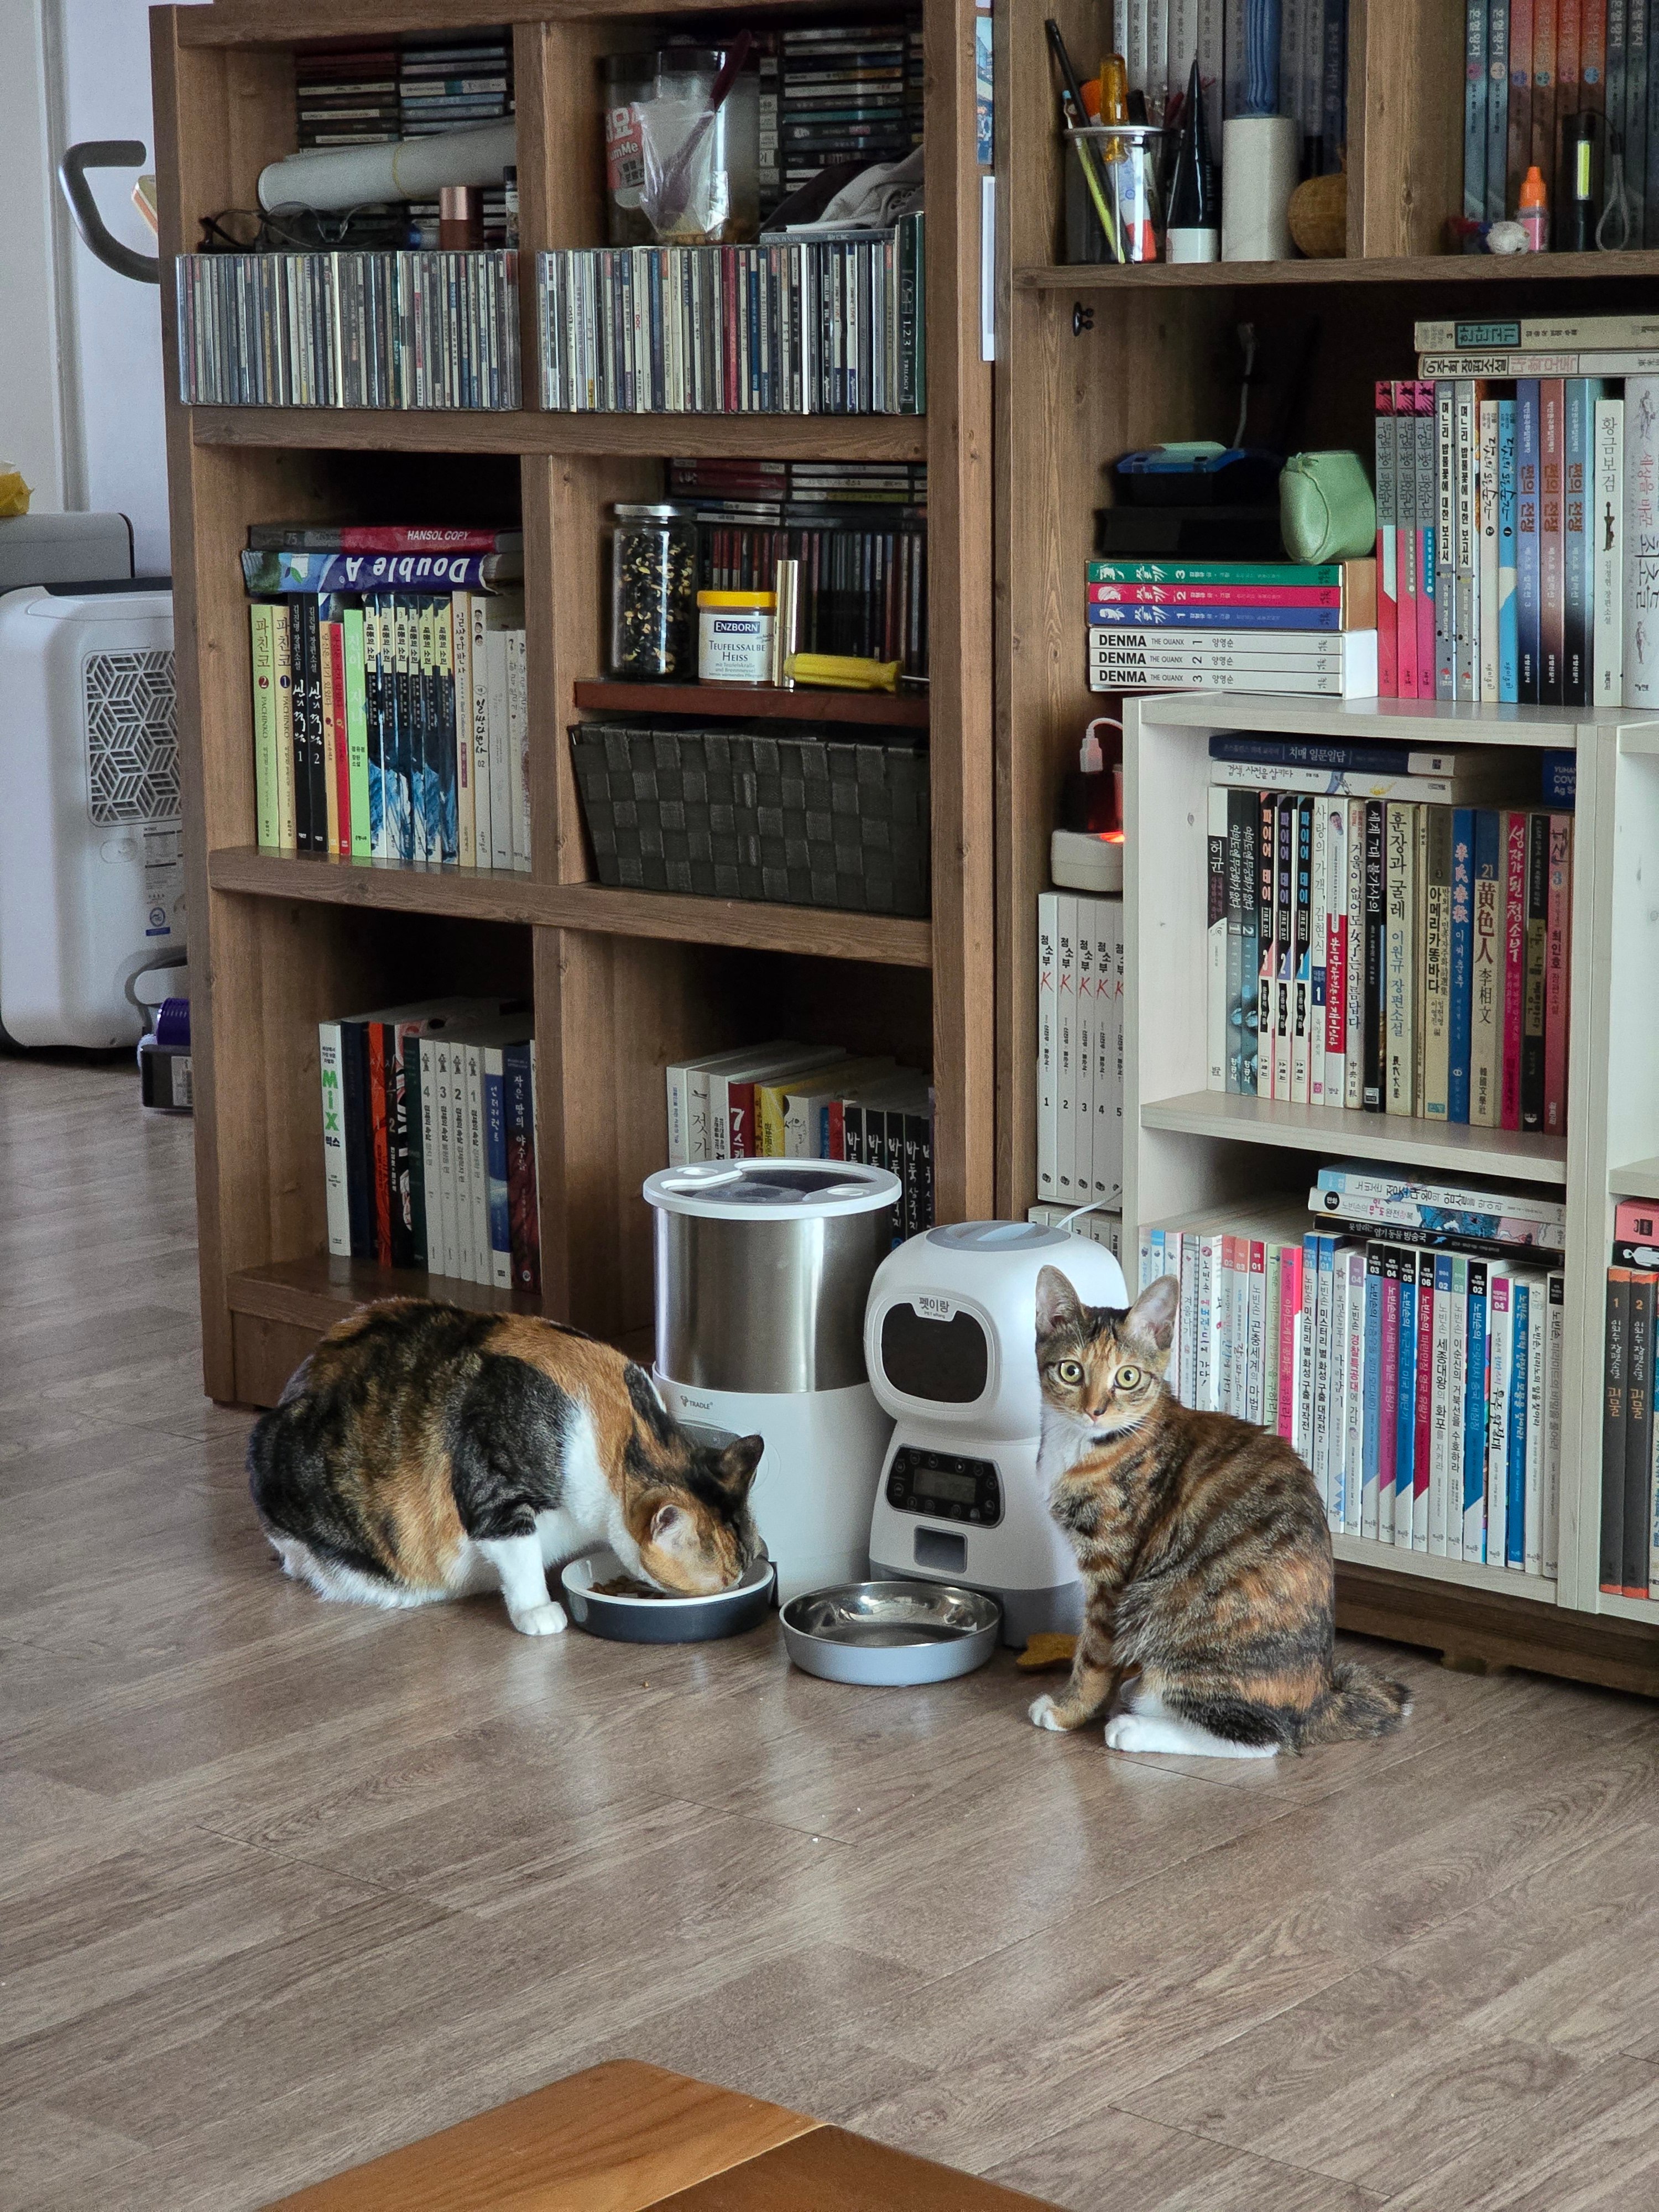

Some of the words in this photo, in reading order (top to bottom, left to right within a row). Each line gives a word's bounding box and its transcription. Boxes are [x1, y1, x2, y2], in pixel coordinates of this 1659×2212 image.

[1459, 326, 1516, 343] 한단고기
[1460, 358, 1507, 374] 장편소설
[1441, 402, 1450, 439] 며느리
[1460, 405, 1469, 442] 며느리
[1441, 444, 1450, 491] 밥풀꽃에
[1483, 436, 1496, 469] 당신의
[1601, 417, 1618, 493] 황금보검
[1460, 447, 1469, 495] 밥풀꽃에
[1520, 464, 1535, 495] 쩐의
[1544, 463, 1559, 494] 쩐의
[1637, 451, 1655, 495] 세상을
[1441, 496, 1450, 521] 대한
[1461, 500, 1469, 525] 대한
[1520, 501, 1535, 533] 전쟁
[1544, 500, 1559, 533] 전쟁
[1637, 499, 1653, 528] 바꾼
[406, 530, 442, 541] HANSOL
[1441, 525, 1450, 562] 보고서
[1461, 529, 1469, 566] 보고서
[346, 557, 364, 582] A
[372, 556, 470, 583] Double
[276, 617, 291, 667] 파친코
[367, 624, 375, 645] 태풍의
[382, 624, 390, 646] 태풍의
[398, 624, 406, 645] 태풍의
[716, 622, 758, 632] ENZBORN
[1099, 634, 1147, 647] DENMA
[1212, 638, 1234, 648] 양영순
[255, 618, 270, 668] 파친코
[293, 634, 301, 671] 장편소설
[367, 646, 375, 662] 소리
[382, 648, 390, 663] 소리
[398, 647, 406, 662] 소리
[708, 640, 766, 651] TEUFELSSALBE
[722, 651, 748, 661] HEISS
[1099, 651, 1146, 665] DENMA
[1212, 656, 1233, 666] 양영순
[1099, 670, 1147, 683] DENMA
[1212, 675, 1234, 684] 양영순
[478, 760, 485, 768] 02
[1288, 747, 1307, 760] 치매
[1309, 748, 1347, 763] 일문일답
[1227, 764, 1244, 778] 검색,
[1245, 765, 1268, 779] 사전을
[1269, 768, 1293, 780] 삼키다
[1262, 809, 1272, 858] 파이어
[1280, 812, 1290, 860] 파이어
[1316, 805, 1326, 856] 사랑의
[1367, 810, 1381, 834] 세계
[1210, 839, 1224, 874] 허균
[1229, 825, 1241, 858] 여의도엔
[1366, 838, 1381, 858] 7대
[1389, 811, 1407, 875] 훈장과
[1508, 825, 1524, 873] 성자가
[1229, 858, 1241, 890] 무궁화가
[1350, 842, 1363, 884] 거울이
[1481, 864, 1493, 878] 21
[1261, 869, 1271, 901] 데이
[1280, 872, 1289, 904] 데이
[1315, 860, 1326, 901] 가객,
[1366, 862, 1380, 914] 불가사의
[1509, 875, 1522, 898] 된
[1349, 886, 1363, 926] 없어도
[1389, 880, 1407, 921] 굴레
[1315, 906, 1326, 956] 김현식
[1428, 887, 1441, 994] 아메리카똥바다
[1507, 901, 1522, 963] 청소부
[1041, 935, 1053, 966] 청소부
[1348, 928, 1361, 971] 女子는
[1390, 930, 1405, 974] 이원규
[1551, 930, 1561, 969] 최인호
[1040, 971, 1055, 993] K
[1478, 968, 1492, 1024] 李相文
[1348, 972, 1361, 1029] 아름답다
[514, 1075, 524, 1100] 작은
[515, 1103, 525, 1129] 땅의
[325, 1136, 340, 1148] 믹스
[691, 1112, 711, 1159] 젓가
[515, 1134, 526, 1171] 야수들
[906, 1141, 920, 1182] 바둑
[909, 1187, 919, 1230] 삼국지
[1327, 1196, 1338, 1205] 만화
[1342, 1202, 1368, 1213] 노빈손의
[1385, 1208, 1413, 1221] 완전정복
[1355, 1181, 1383, 1193] 노빈손
[1386, 1185, 1441, 1203] 정조대왕의
[1443, 1192, 1475, 1207] 암살을
[1478, 1199, 1504, 1211] 막아라
[1374, 1227, 1387, 1238] 엽기
[1388, 1230, 1403, 1240] 동물
[1404, 1231, 1427, 1243] 방송국
[1305, 1276, 1313, 1305] 노빈손
[1402, 1274, 1412, 1282] 05
[919, 1297, 950, 1313] 펫이랑
[1183, 1296, 1193, 1337] 겨울나기
[1369, 1284, 1378, 1318] 노빈손의
[1303, 1306, 1312, 1344] 미스터리
[1319, 1309, 1328, 1346] 미스터리
[1515, 1331, 1526, 1349] 해적
[1532, 1324, 1541, 1350] 노빈손,
[1250, 1320, 1261, 1381] 곤충세계의
[1303, 1347, 1311, 1357] 별
[1386, 1325, 1396, 1363] 시끌벅적
[1401, 1330, 1410, 1366] 두근두근
[1420, 1334, 1430, 1371] 파란만장
[1453, 1338, 1462, 1381] 이순신의
[1198, 1360, 1209, 1386] 가다!
[1302, 1359, 1311, 1379] 화성
[1349, 1334, 1360, 1402] 경찰특공대에
[1385, 1364, 1395, 1381] 일본
[1436, 1338, 1448, 1400] 세종대왕의
[1472, 1343, 1481, 1379] 으랏차차
[1532, 1352, 1542, 1383] 티라노의
[1302, 1381, 1311, 1400] 구출
[1401, 1370, 1410, 1389] 미국
[1419, 1374, 1428, 1393] 영국
[1471, 1381, 1480, 1400] 중국
[1514, 1381, 1525, 1409] 보물을
[689, 1400, 711, 1410] TRADLE
[1385, 1386, 1395, 1412] 원정기
[1400, 1392, 1408, 1420] 횡단기
[1417, 1395, 1428, 1423] 유랑기
[1452, 1385, 1461, 1427] 거북선을
[1607, 1387, 1620, 1417] 괴물
[1302, 1402, 1310, 1431] 대작전
[1317, 1405, 1326, 1433] 대작전
[1349, 1406, 1358, 1426] 가다
[1470, 1403, 1480, 1431] 대장정
[1514, 1412, 1525, 1440] 찾아라
[1451, 1431, 1461, 1473] 수호하라
